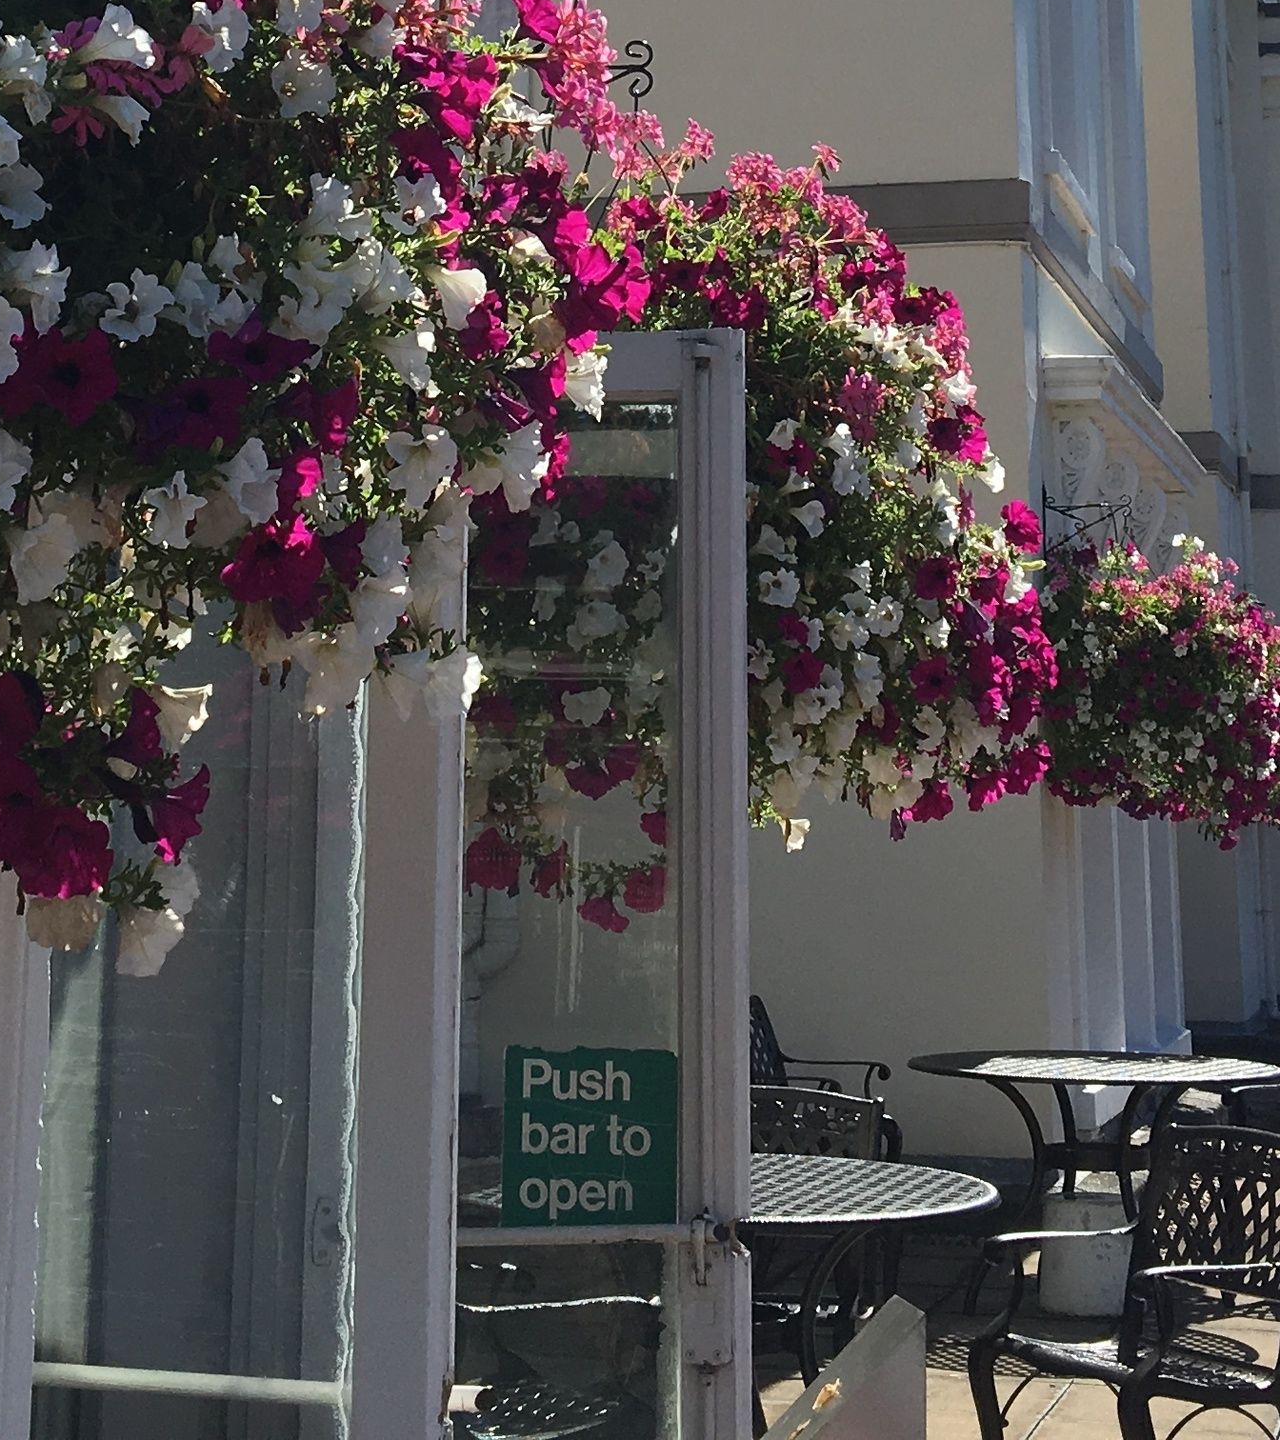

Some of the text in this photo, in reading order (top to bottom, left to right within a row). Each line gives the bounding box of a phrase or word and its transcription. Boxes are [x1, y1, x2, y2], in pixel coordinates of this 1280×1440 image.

[522, 1058, 631, 1101] Push
[521, 1112, 652, 1157] bar to
[519, 1177, 633, 1220] open
